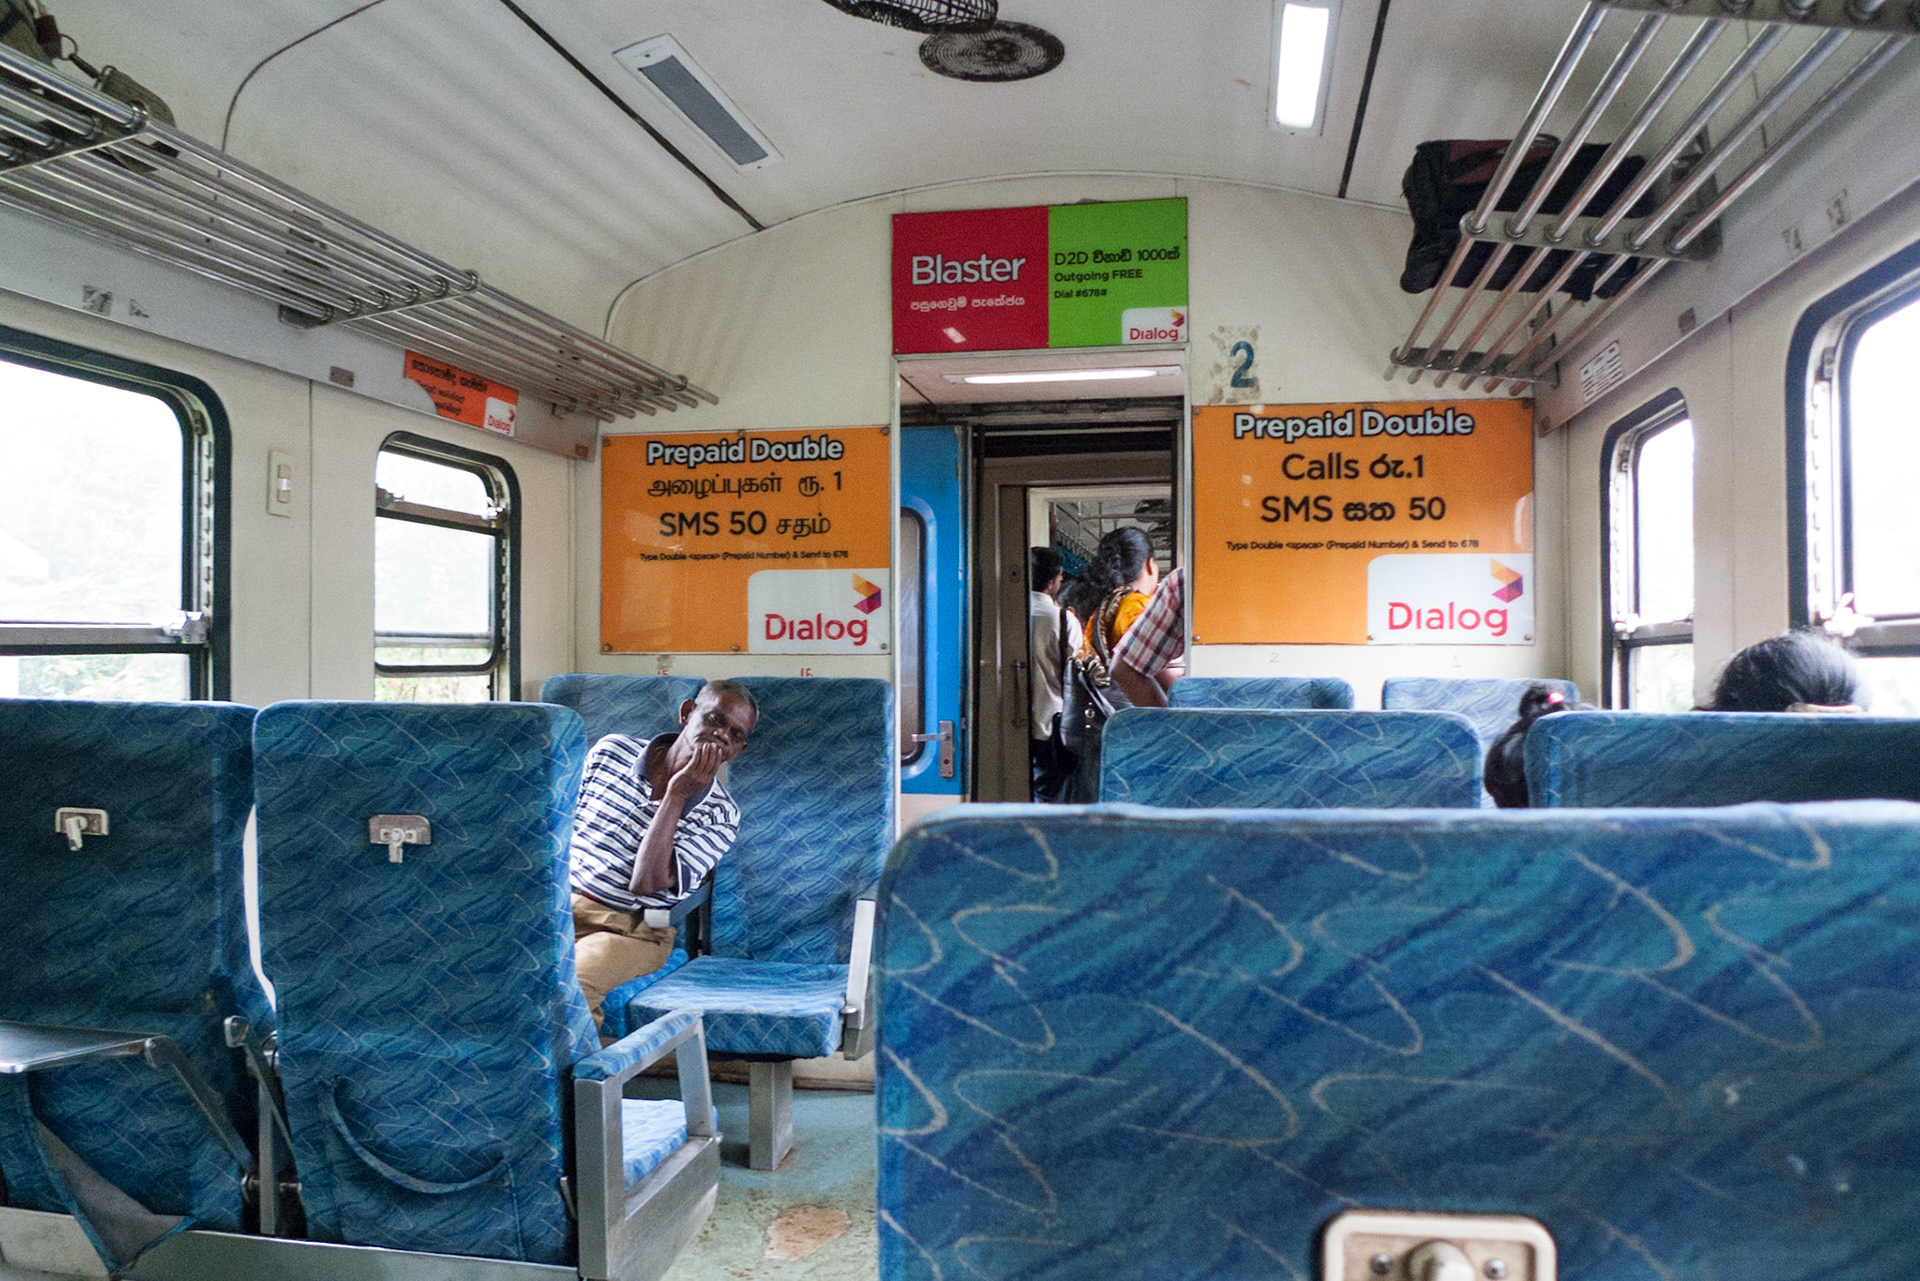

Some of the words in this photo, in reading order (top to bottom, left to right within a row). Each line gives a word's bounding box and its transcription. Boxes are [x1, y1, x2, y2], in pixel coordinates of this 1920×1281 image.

[911, 253, 1027, 285] Blaster
[1054, 251, 1089, 266] D2D
[1054, 271, 1110, 283] Outgoing
[1112, 269, 1143, 279] FREE
[1054, 290, 1073, 298] Dial
[1075, 289, 1107, 298] #678#
[1129, 328, 1179, 341] Dialog
[1230, 340, 1255, 388] 2
[1234, 408, 1355, 444] Prepaid
[1360, 406, 1475, 437] Double
[646, 437, 746, 469] Prepaid
[750, 434, 844, 462] Double
[1281, 452, 1360, 480] Calls
[647, 473, 783, 500] அழைப்புகள்
[833, 471, 842, 491] 1
[1261, 495, 1334, 523] SMS
[1408, 497, 1447, 521] 50
[659, 511, 720, 537] SMS
[729, 511, 767, 535] 50
[776, 512, 832, 541] சதம்
[659, 552, 687, 560] Double
[1226, 541, 1248, 551] Type
[1250, 541, 1283, 549] Double
[1368, 540, 1409, 549] Number)
[1411, 540, 1418, 548] &
[1422, 540, 1445, 548] Send
[1448, 540, 1458, 548] to
[1461, 540, 1479, 548] 678
[765, 613, 868, 646] Dialog
[1388, 601, 1508, 637] Dialog
